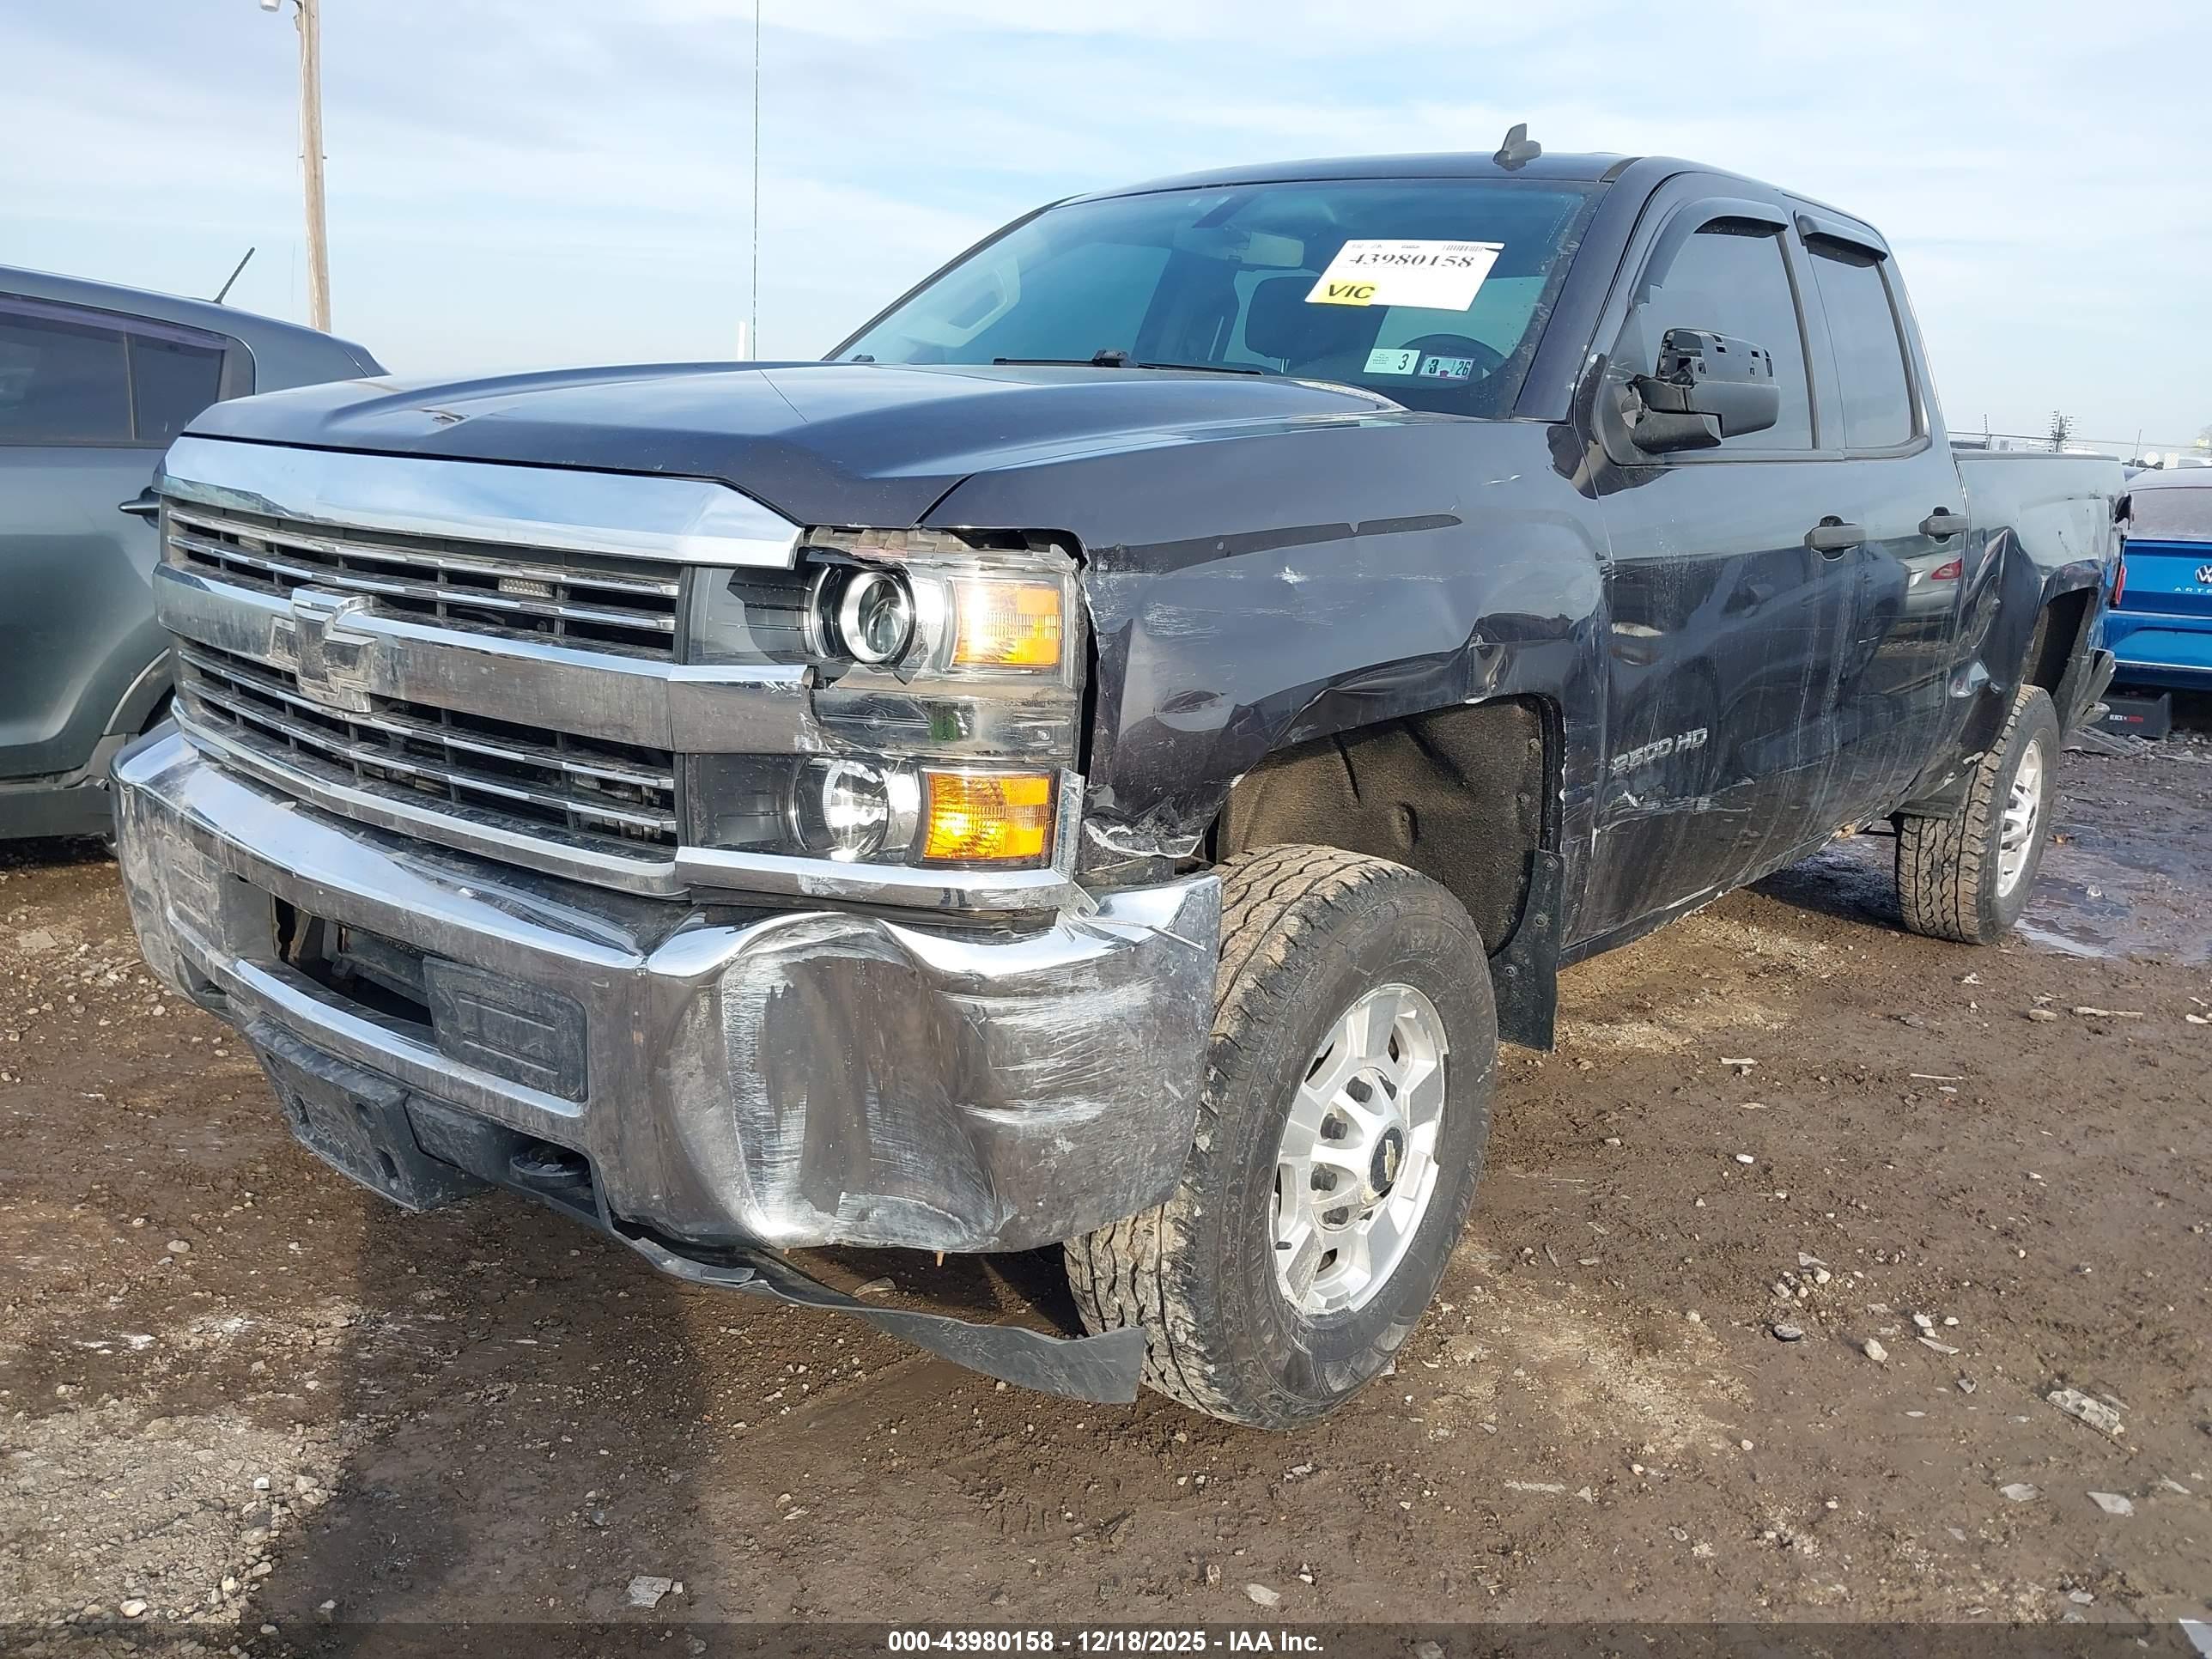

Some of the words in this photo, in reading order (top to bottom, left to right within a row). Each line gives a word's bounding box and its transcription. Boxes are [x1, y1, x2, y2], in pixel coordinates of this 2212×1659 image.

[1349, 253, 1474, 268] 43980158
[1328, 284, 1376, 299] VIC
[1398, 353, 1410, 371] 3
[1428, 358, 1440, 374] 3
[1455, 361, 1471, 376] 26
[1611, 737, 1674, 773] 2500
[1674, 727, 1708, 753] HD
